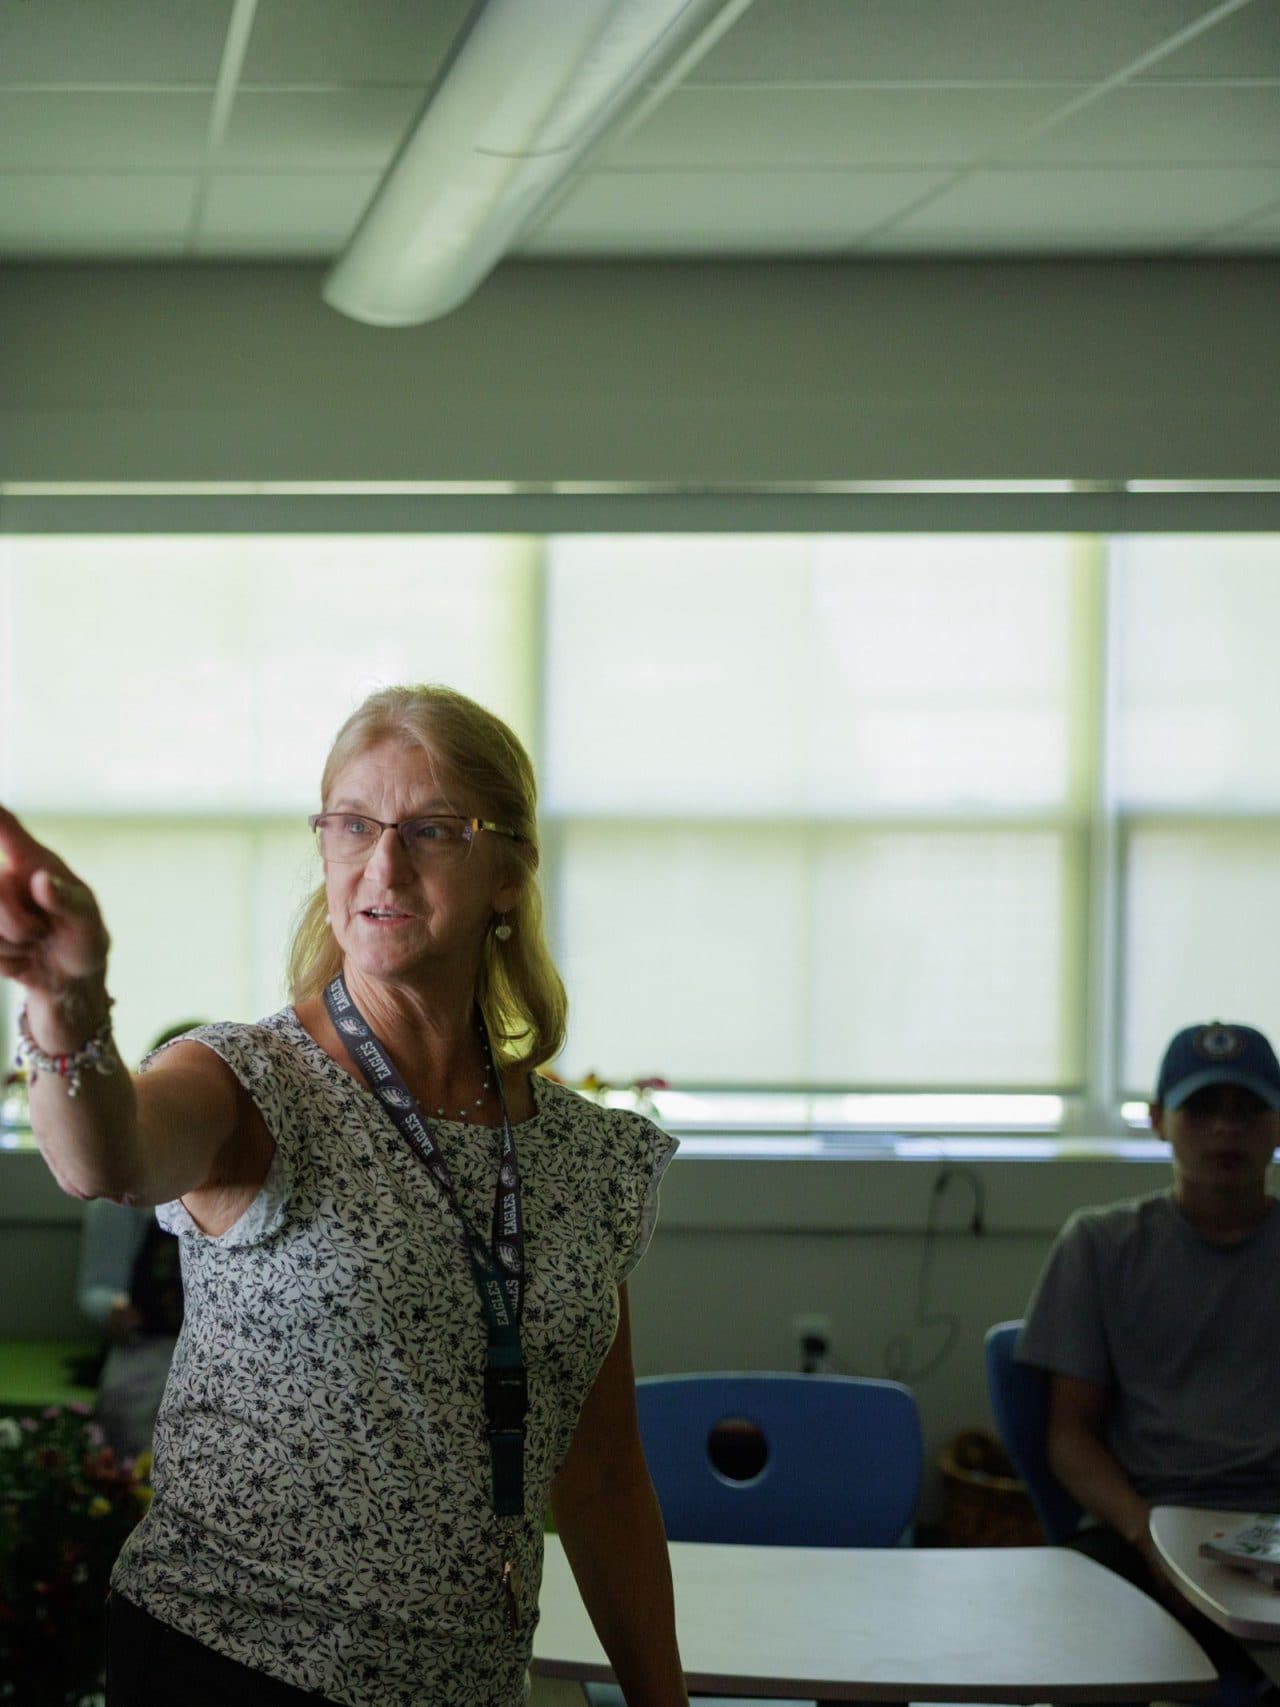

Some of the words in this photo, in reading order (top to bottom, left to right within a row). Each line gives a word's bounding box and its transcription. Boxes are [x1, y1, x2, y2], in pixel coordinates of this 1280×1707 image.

[330, 978, 351, 1012] EAGLE
[360, 1041, 392, 1080] EAGLES
[405, 1113, 434, 1157] EAGLES
[503, 1193, 518, 1235] EAGLES
[486, 1279, 509, 1328] EAGLES
